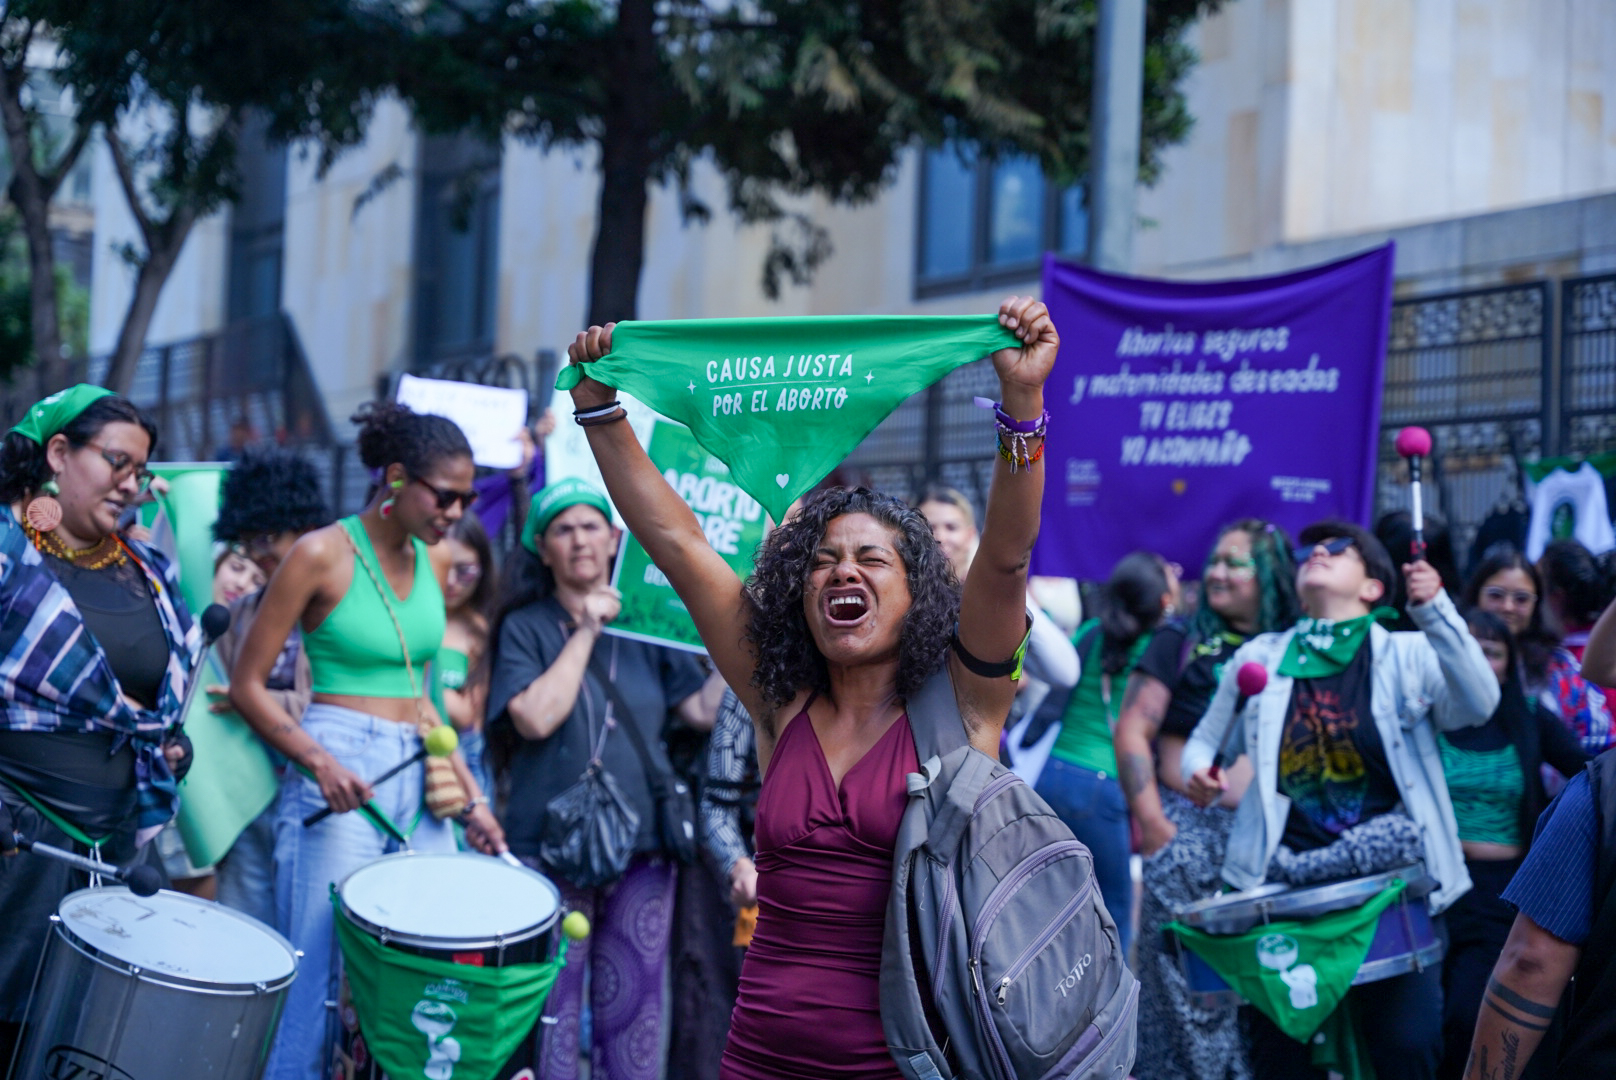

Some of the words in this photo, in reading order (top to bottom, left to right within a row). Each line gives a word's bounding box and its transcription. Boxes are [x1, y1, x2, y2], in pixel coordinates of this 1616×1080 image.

[1202, 326, 1290, 362] seguros
[706, 356, 776, 383] CAUSA
[782, 353, 853, 378] JUSTA
[1229, 353, 1340, 393] deseadas
[712, 392, 743, 417] POR
[750, 389, 768, 413] EL
[776, 386, 848, 412] ABORTO
